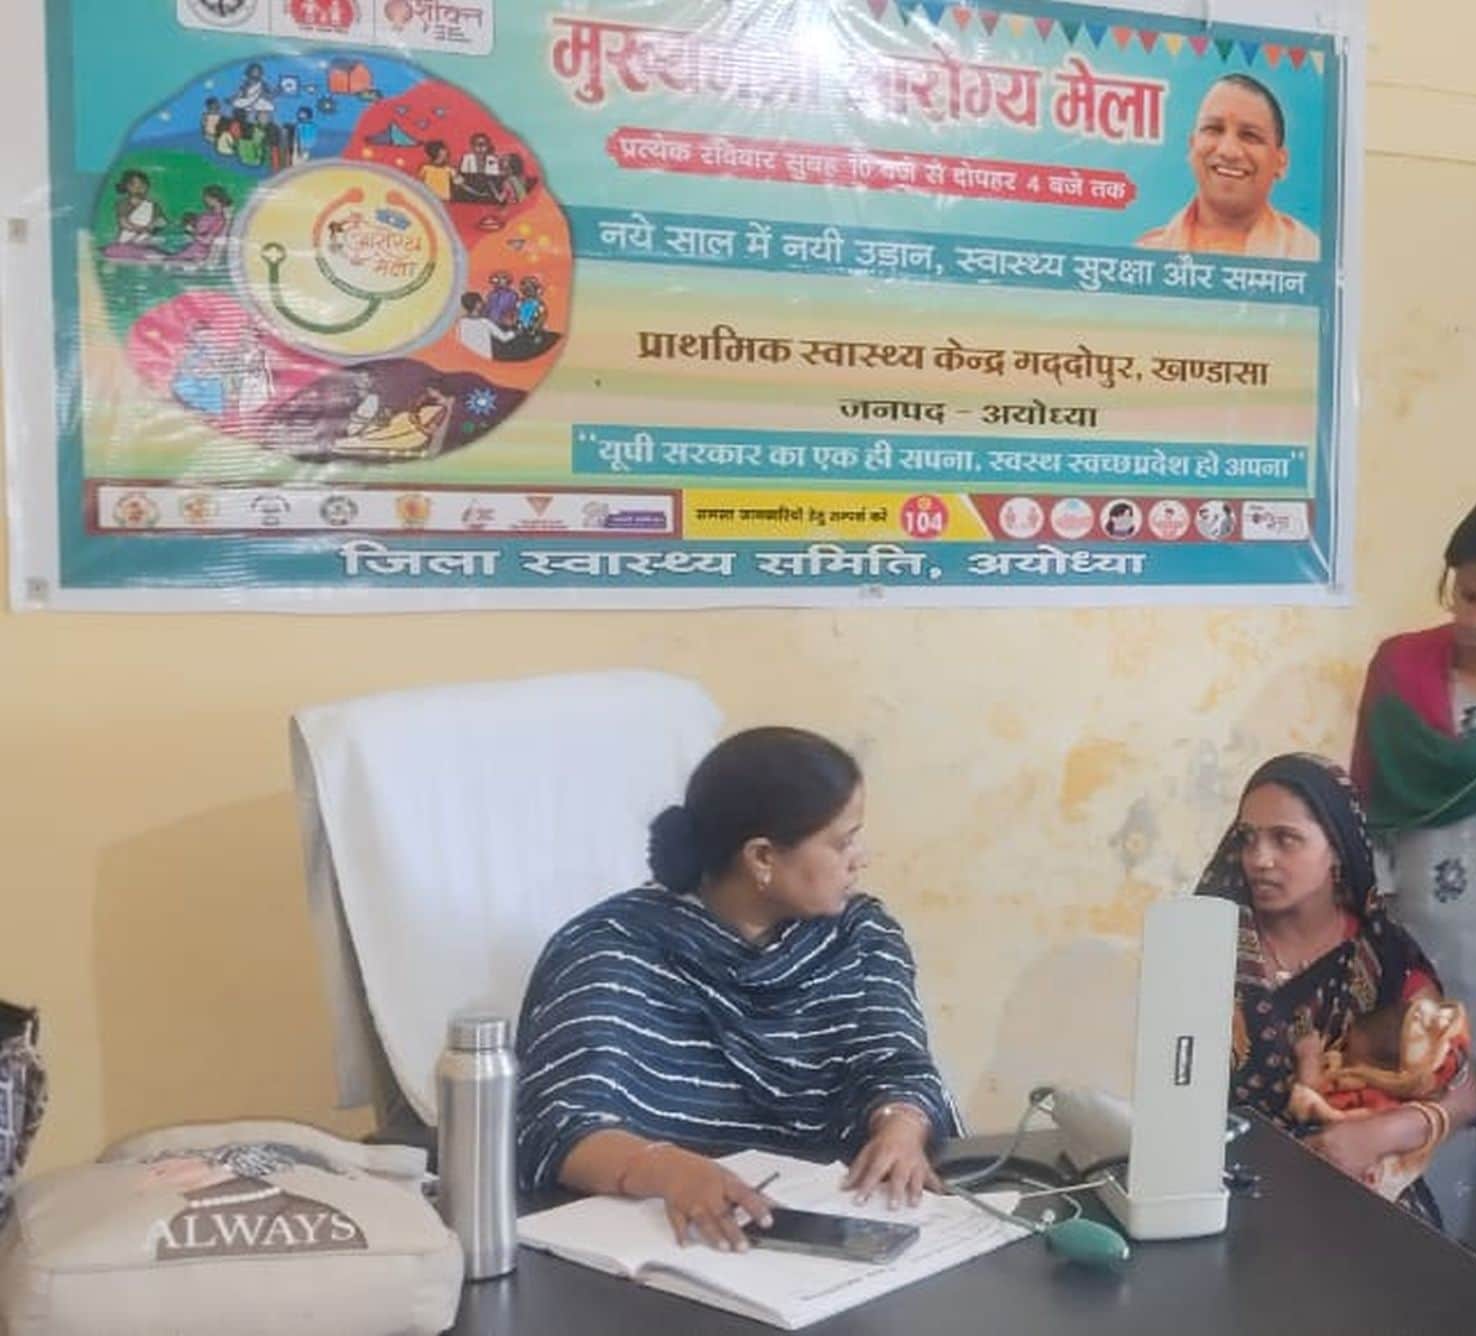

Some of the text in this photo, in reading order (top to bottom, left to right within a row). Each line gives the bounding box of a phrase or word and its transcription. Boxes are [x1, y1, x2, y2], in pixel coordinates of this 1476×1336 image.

[552, 17, 832, 110] मुख्यम
[1053, 57, 1164, 139] मेला
[619, 133, 692, 161] प्रत्येक
[923, 159, 944, 185] से
[951, 161, 1018, 192] दोपहर
[1027, 175, 1040, 193] 4
[1048, 172, 1083, 196] बजे
[1091, 181, 1127, 200] तक
[598, 213, 655, 250] नये
[665, 226, 735, 257] साल
[745, 222, 772, 258] में
[783, 226, 844, 262] नयी
[955, 247, 1066, 279] स्वास्थ्य
[1074, 255, 1154, 291] सुरक्षा
[1163, 254, 1215, 289] और
[1221, 266, 1305, 295] सम्मान
[637, 325, 792, 363] प्राथमिक
[800, 339, 926, 370] स्वास्थ्य
[933, 338, 1006, 378] केन्द्र
[1151, 356, 1270, 387] खण्डासा
[840, 399, 945, 424] जनपद
[982, 400, 1099, 428] अयोध्या
[662, 441, 761, 466] सरकार
[769, 447, 805, 468] का
[812, 448, 857, 471] एक
[863, 438, 893, 469] ही
[987, 451, 1063, 472] स्वस्थ
[1195, 448, 1221, 479] हो
[904, 511, 943, 533] 104
[339, 539, 1147, 580] जिला स्वास्थ्य समिति, अयोध्या
[146, 1212, 357, 1252] ALWAYS
